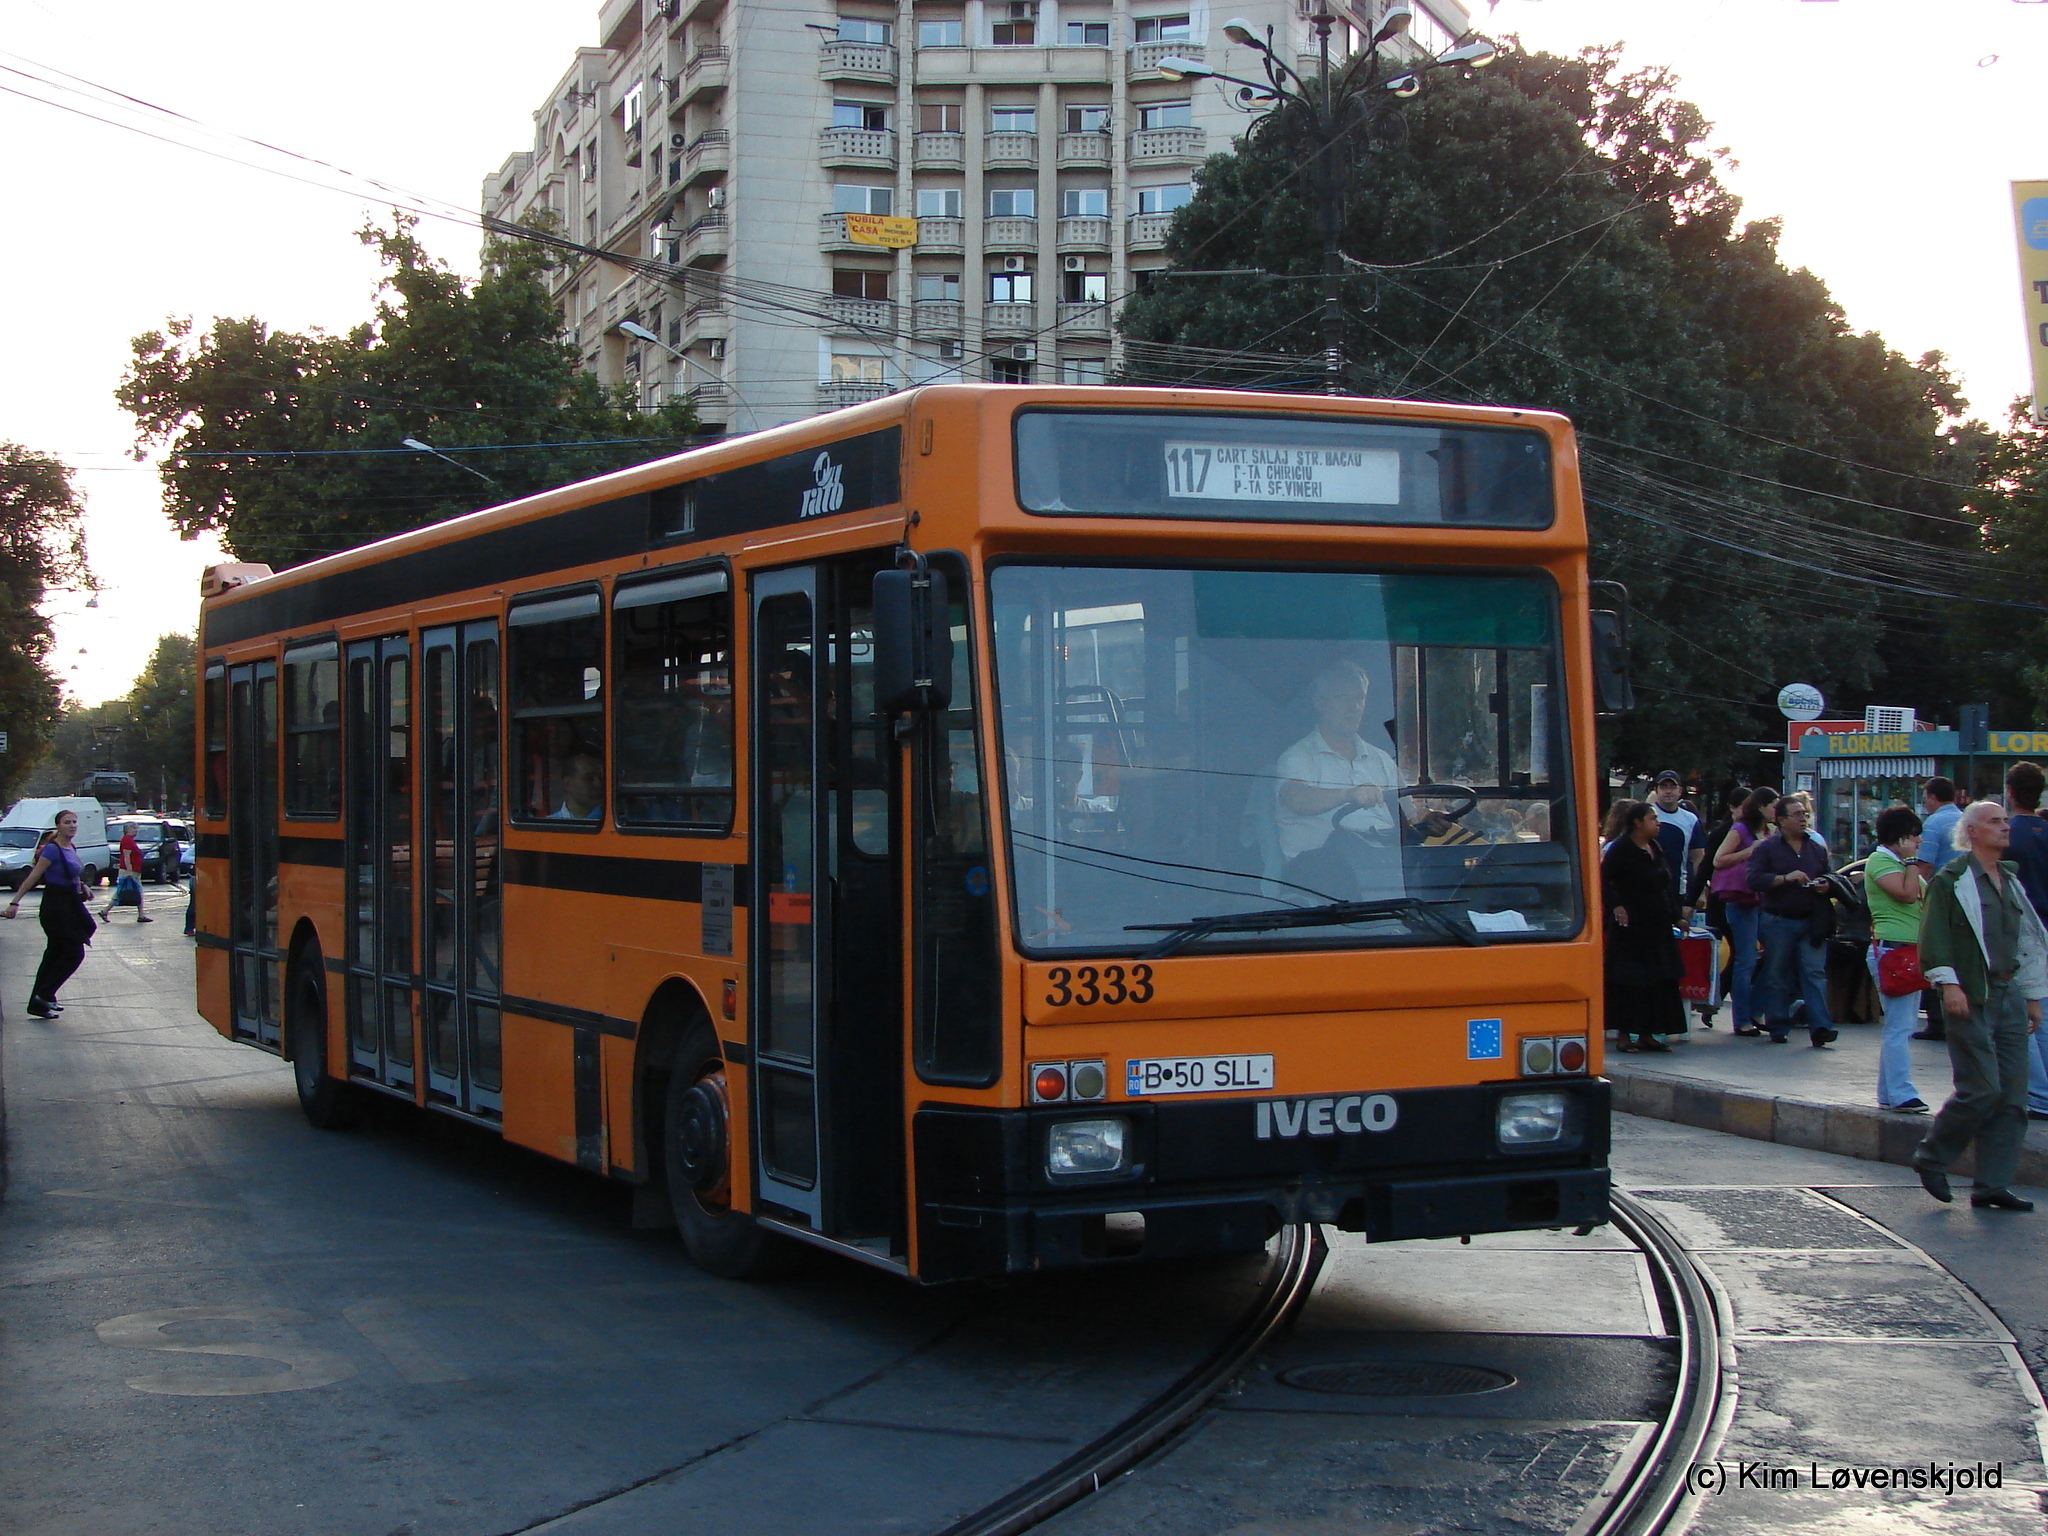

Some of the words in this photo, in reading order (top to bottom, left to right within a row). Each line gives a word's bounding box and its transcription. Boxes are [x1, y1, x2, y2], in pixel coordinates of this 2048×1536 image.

[852, 225, 879, 235] CASA
[1217, 449, 1248, 464] CART.
[1252, 449, 1288, 465] SALAJ
[1296, 450, 1322, 466] STR.
[1167, 448, 1212, 493] 117
[1266, 465, 1312, 481] CHIRIGIU
[1234, 480, 1262, 494] P-TA
[1828, 733, 1911, 754] FLORARIE
[1045, 963, 1154, 1007] 3333
[1214, 1059, 1260, 1087] SLL
[1128, 1080, 1140, 1091] RO
[1256, 1094, 1398, 1139] IVECO
